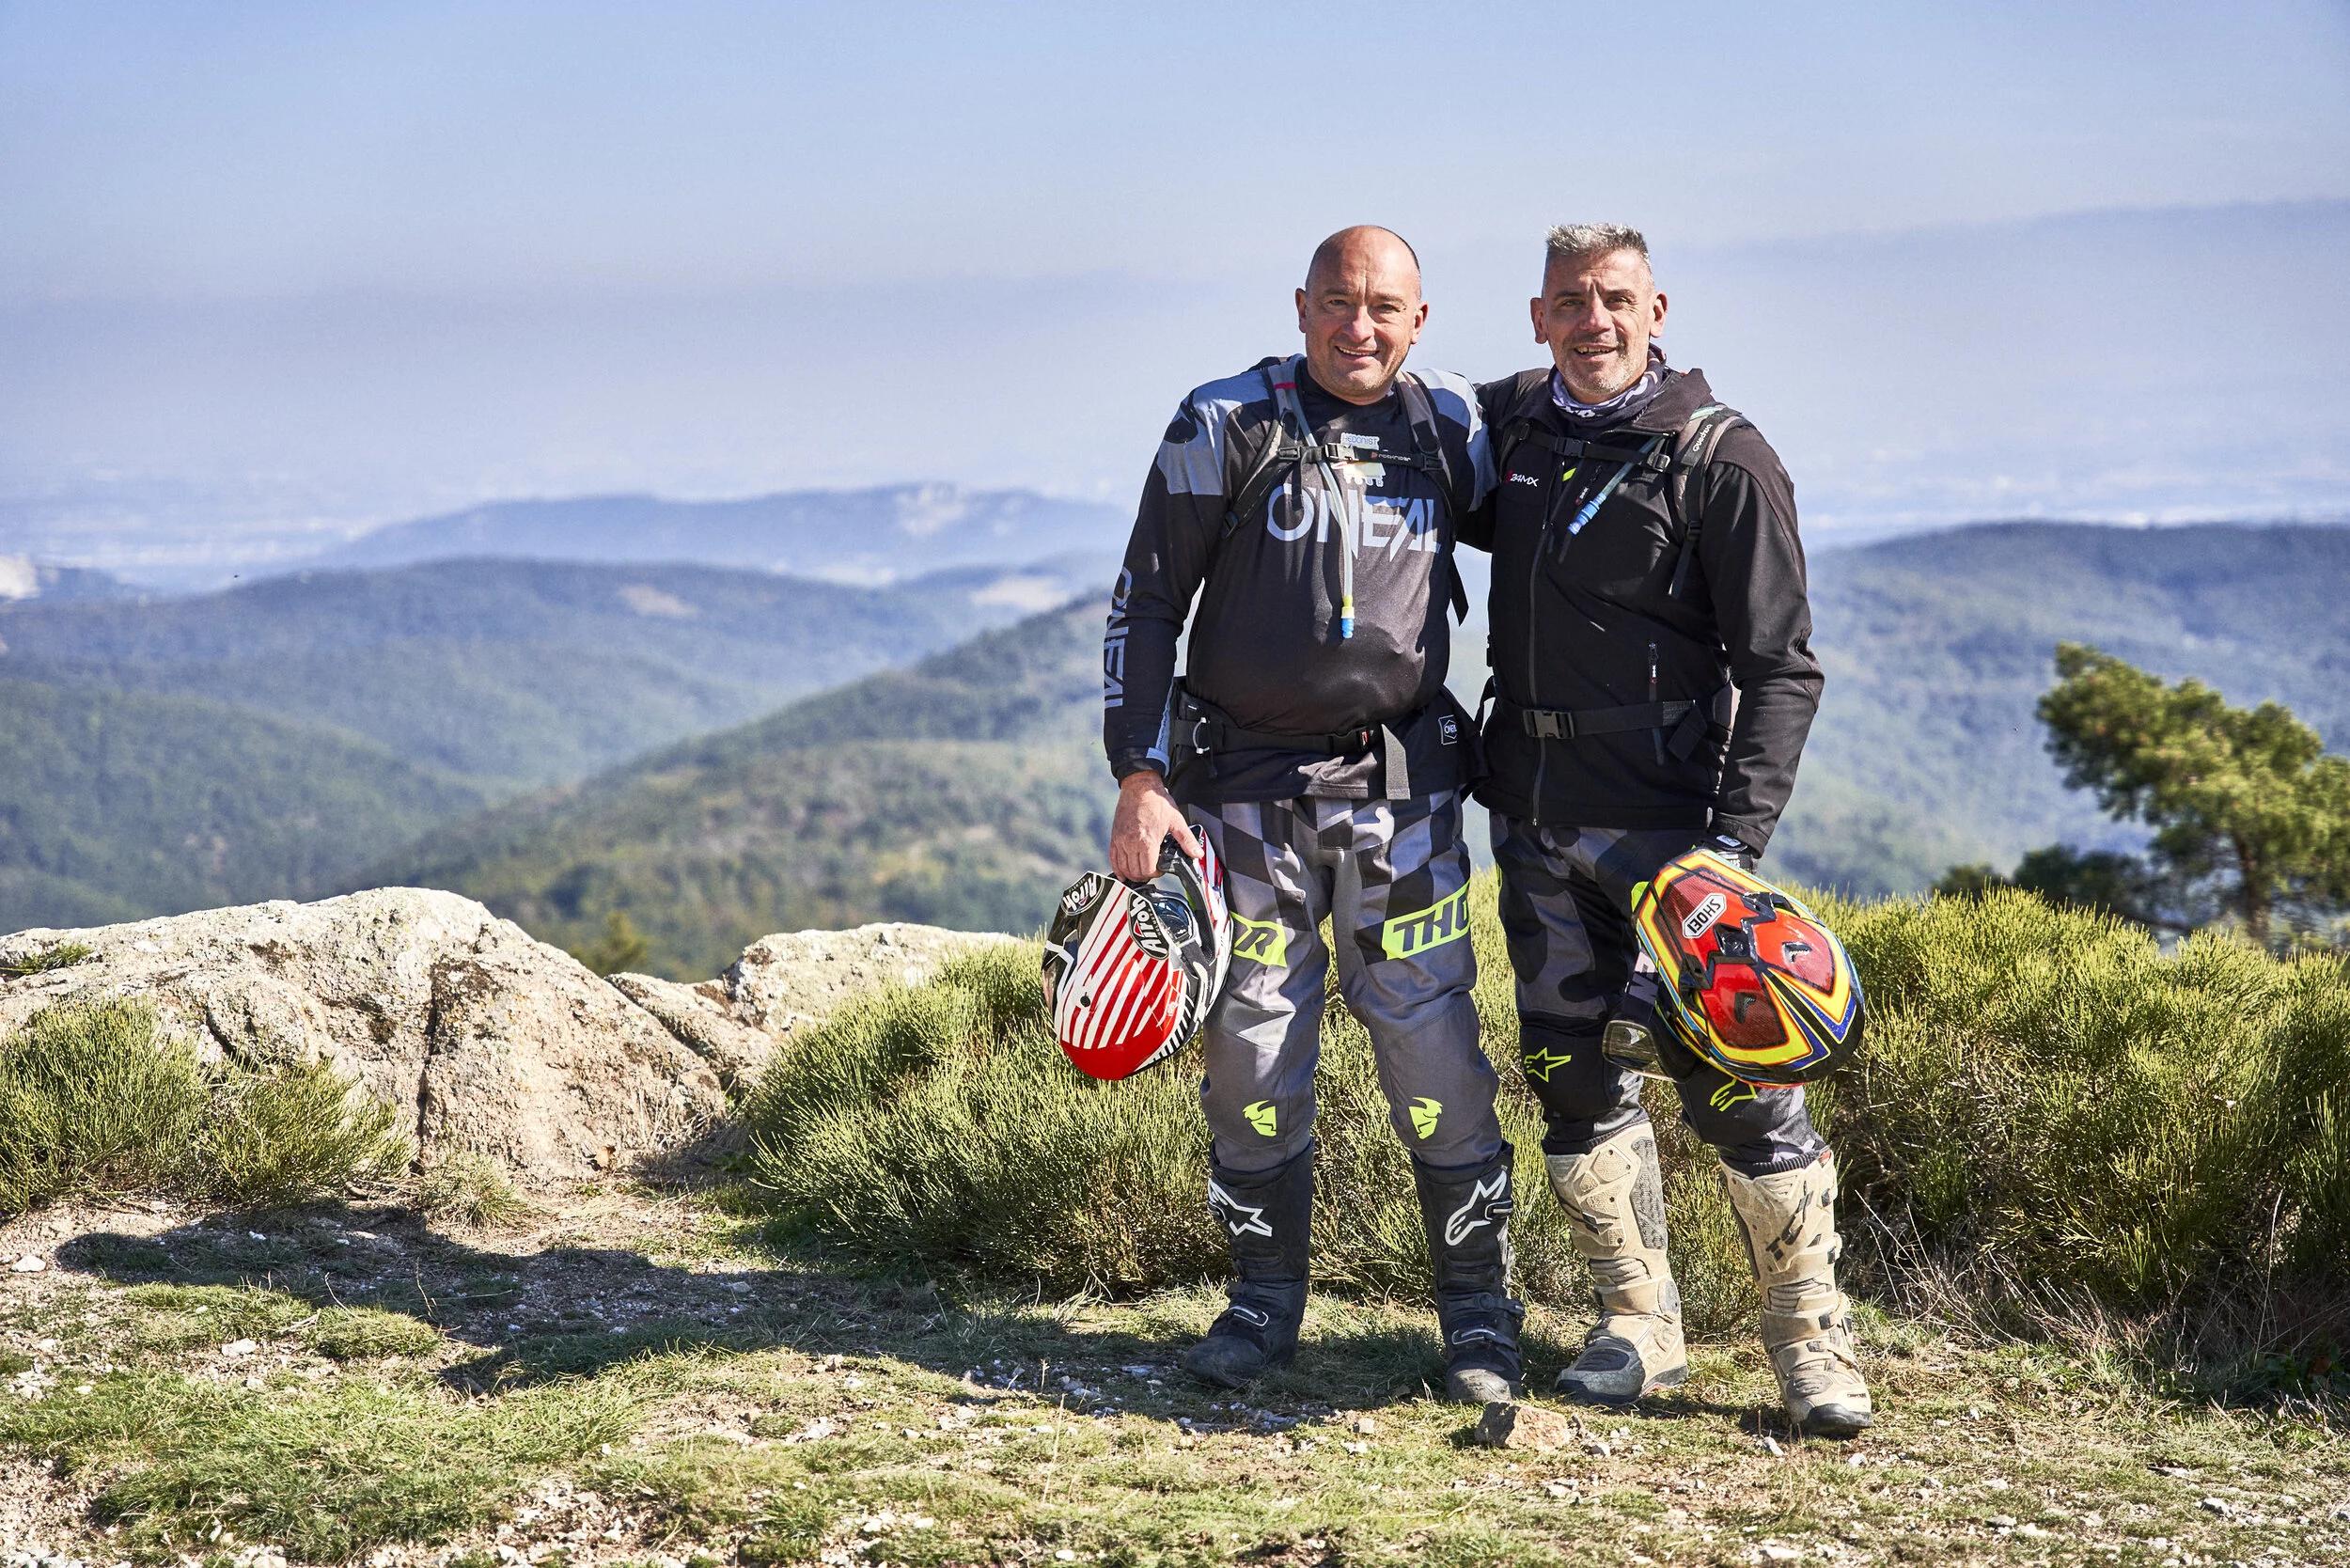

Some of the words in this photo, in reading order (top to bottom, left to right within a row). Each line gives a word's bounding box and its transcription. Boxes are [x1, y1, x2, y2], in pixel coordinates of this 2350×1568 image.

[1692, 423, 1713, 451] Quechua
[1062, 874, 1097, 911] Airoh
[1130, 896, 1168, 954] Airoh
[1687, 899, 1720, 933] SHOEI
